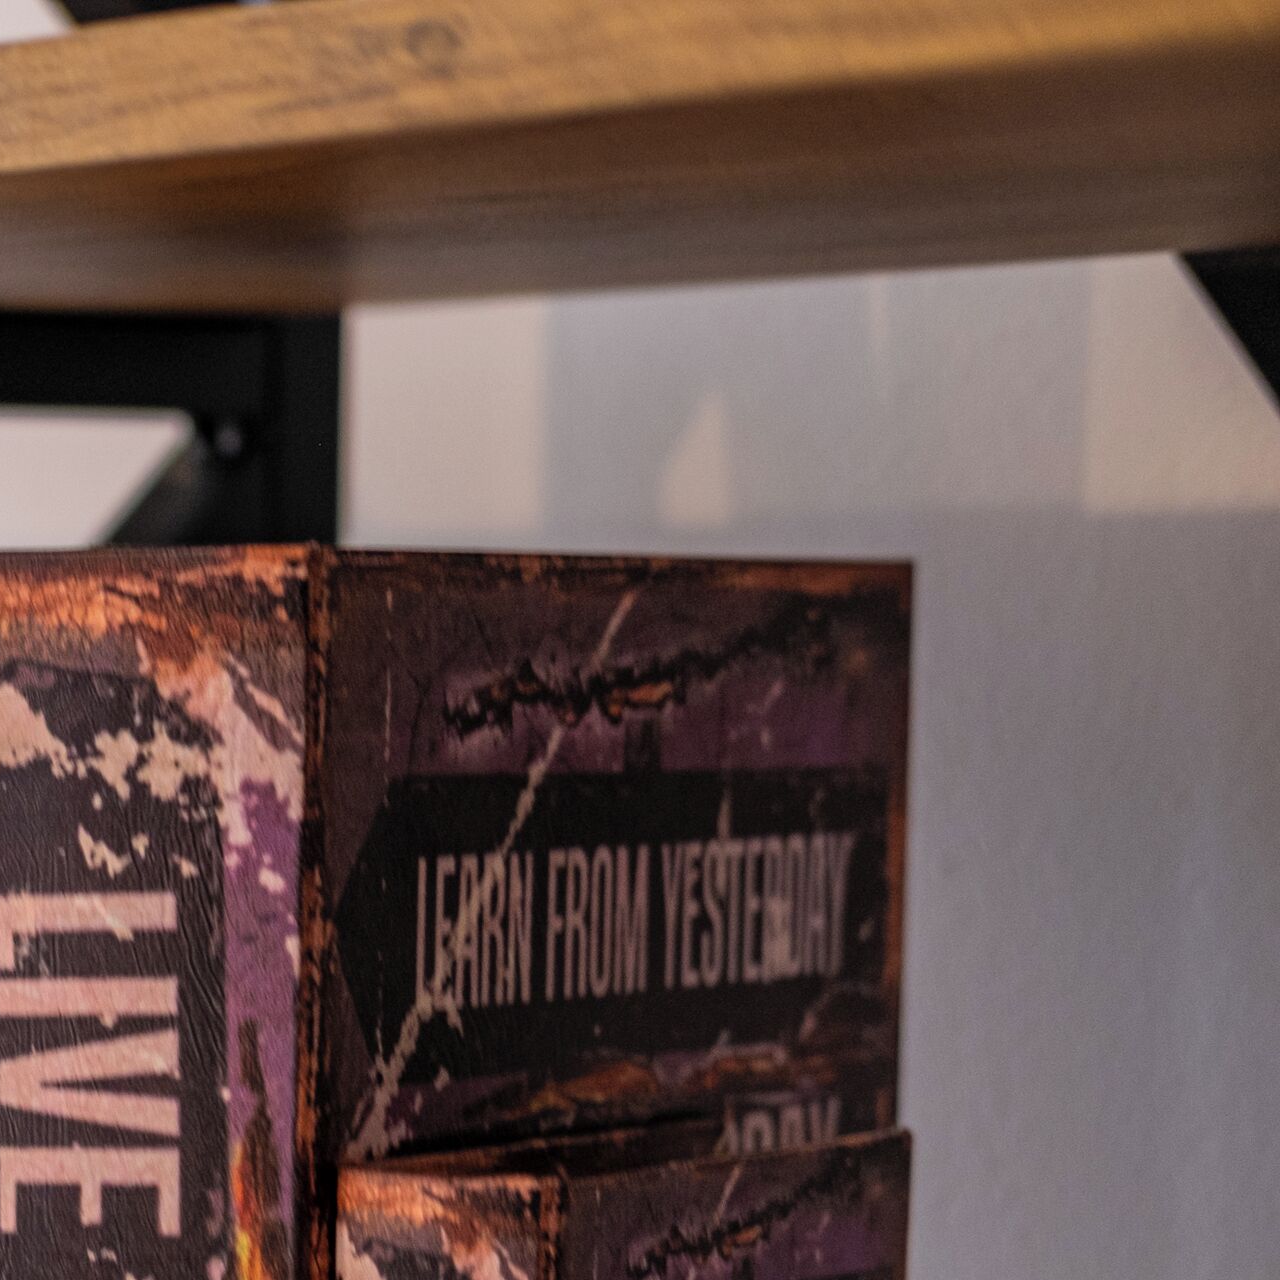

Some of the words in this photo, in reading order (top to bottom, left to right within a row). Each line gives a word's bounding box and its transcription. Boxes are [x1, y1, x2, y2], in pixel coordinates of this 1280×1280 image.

[415, 850, 535, 1007] LEARN
[545, 844, 651, 1001] FROM
[661, 831, 858, 990] YESTERDAY
